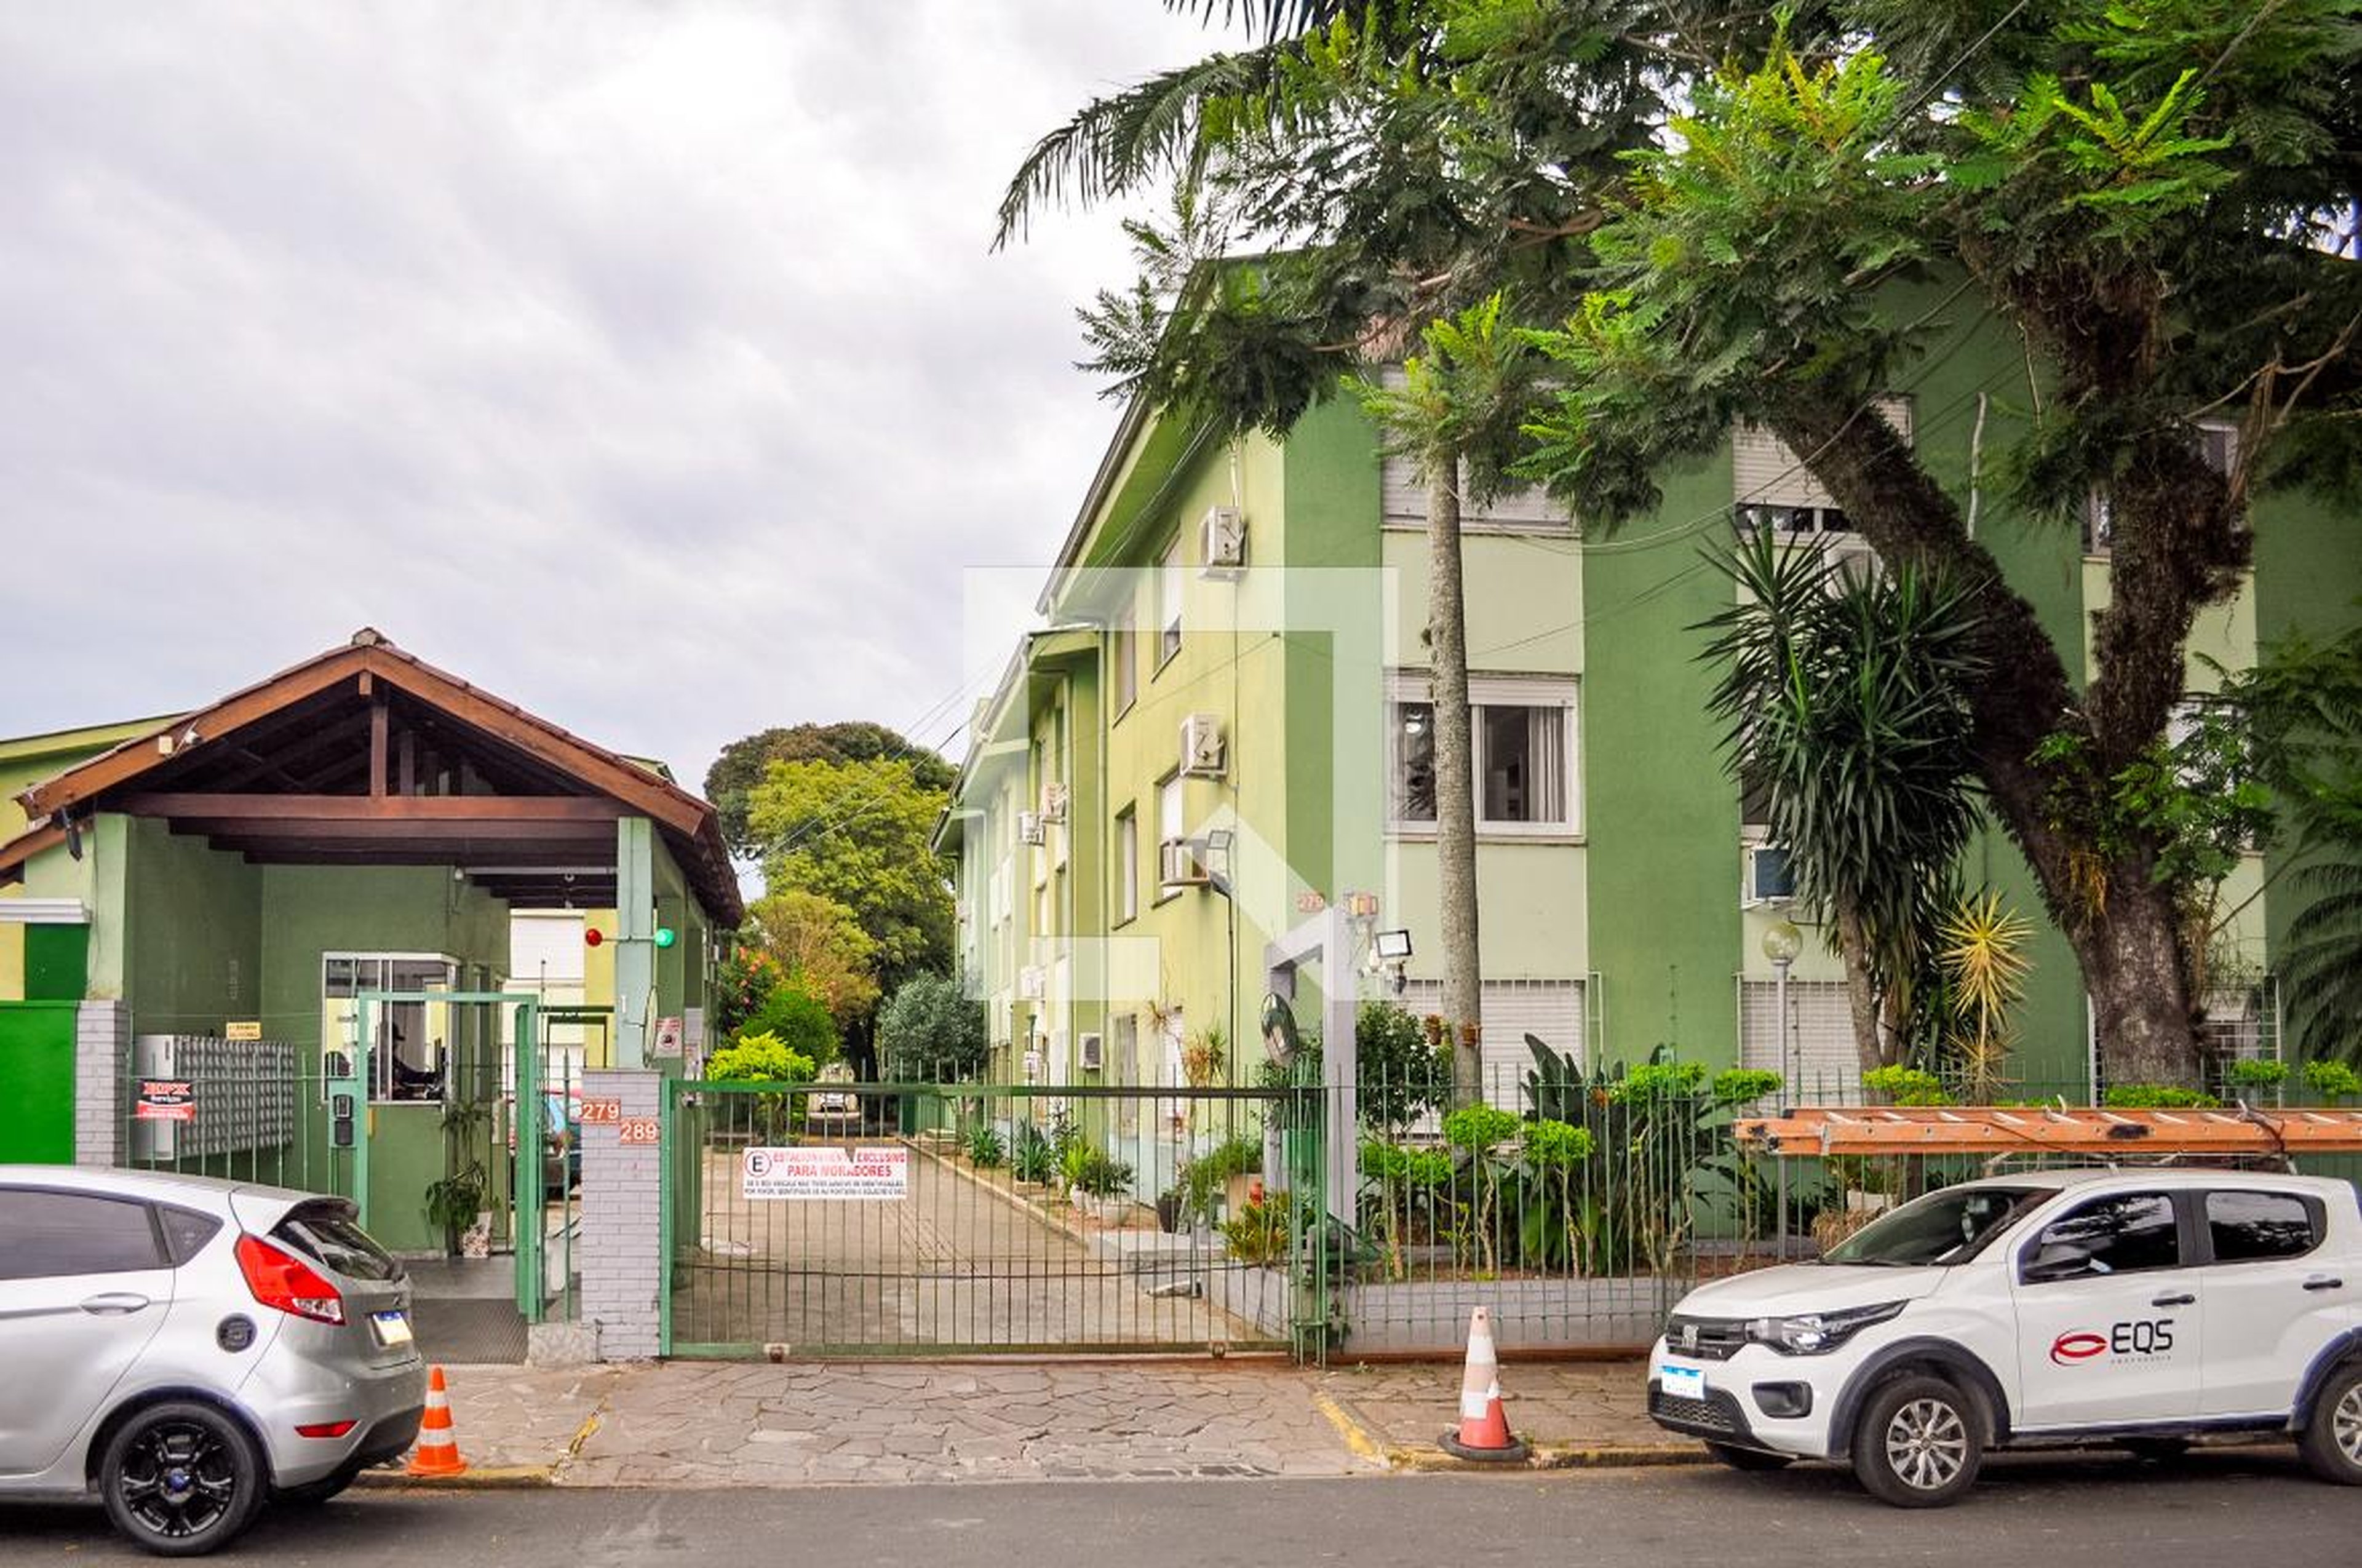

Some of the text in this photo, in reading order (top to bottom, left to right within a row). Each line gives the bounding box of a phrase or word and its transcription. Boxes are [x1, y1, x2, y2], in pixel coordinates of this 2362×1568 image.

[582, 1104, 619, 1120] 279
[620, 1123, 658, 1140] 289
[752, 1155, 763, 1172] E
[773, 1152, 853, 1163] ESTACIONAMENT
[787, 1164, 893, 1177] PARA MORADORES
[2112, 1319, 2173, 1354] EQS
